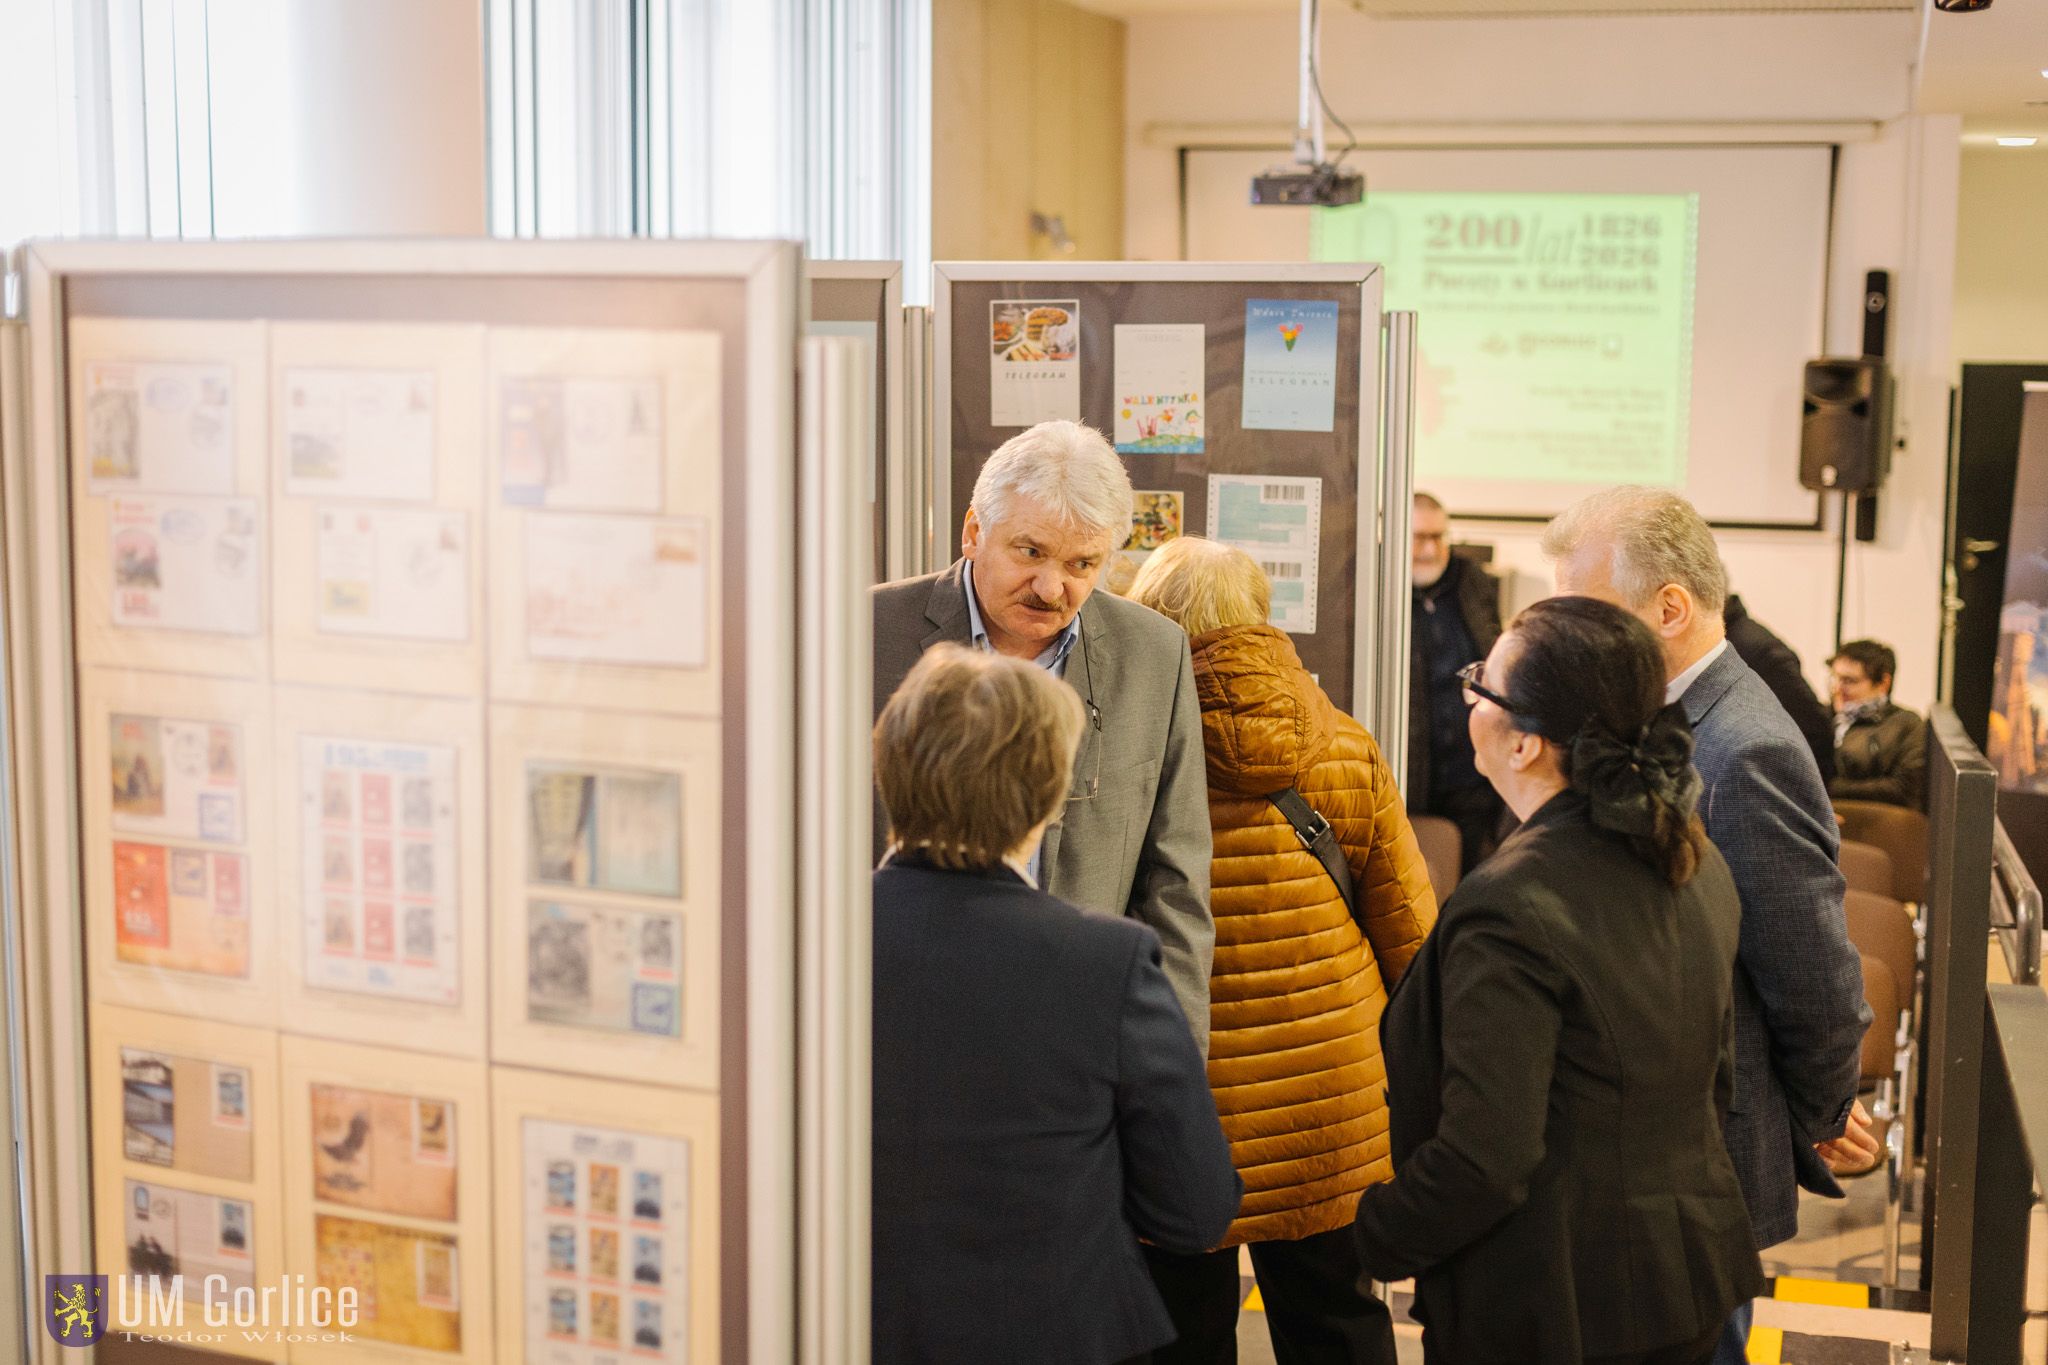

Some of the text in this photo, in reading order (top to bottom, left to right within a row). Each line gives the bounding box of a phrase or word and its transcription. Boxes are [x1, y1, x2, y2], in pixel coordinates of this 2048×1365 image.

[1425, 213, 1522, 249] 200
[1582, 213, 1662, 238] 1826
[1005, 371, 1067, 380] TELEGRAM
[1249, 376, 1331, 387] TELEGRAM
